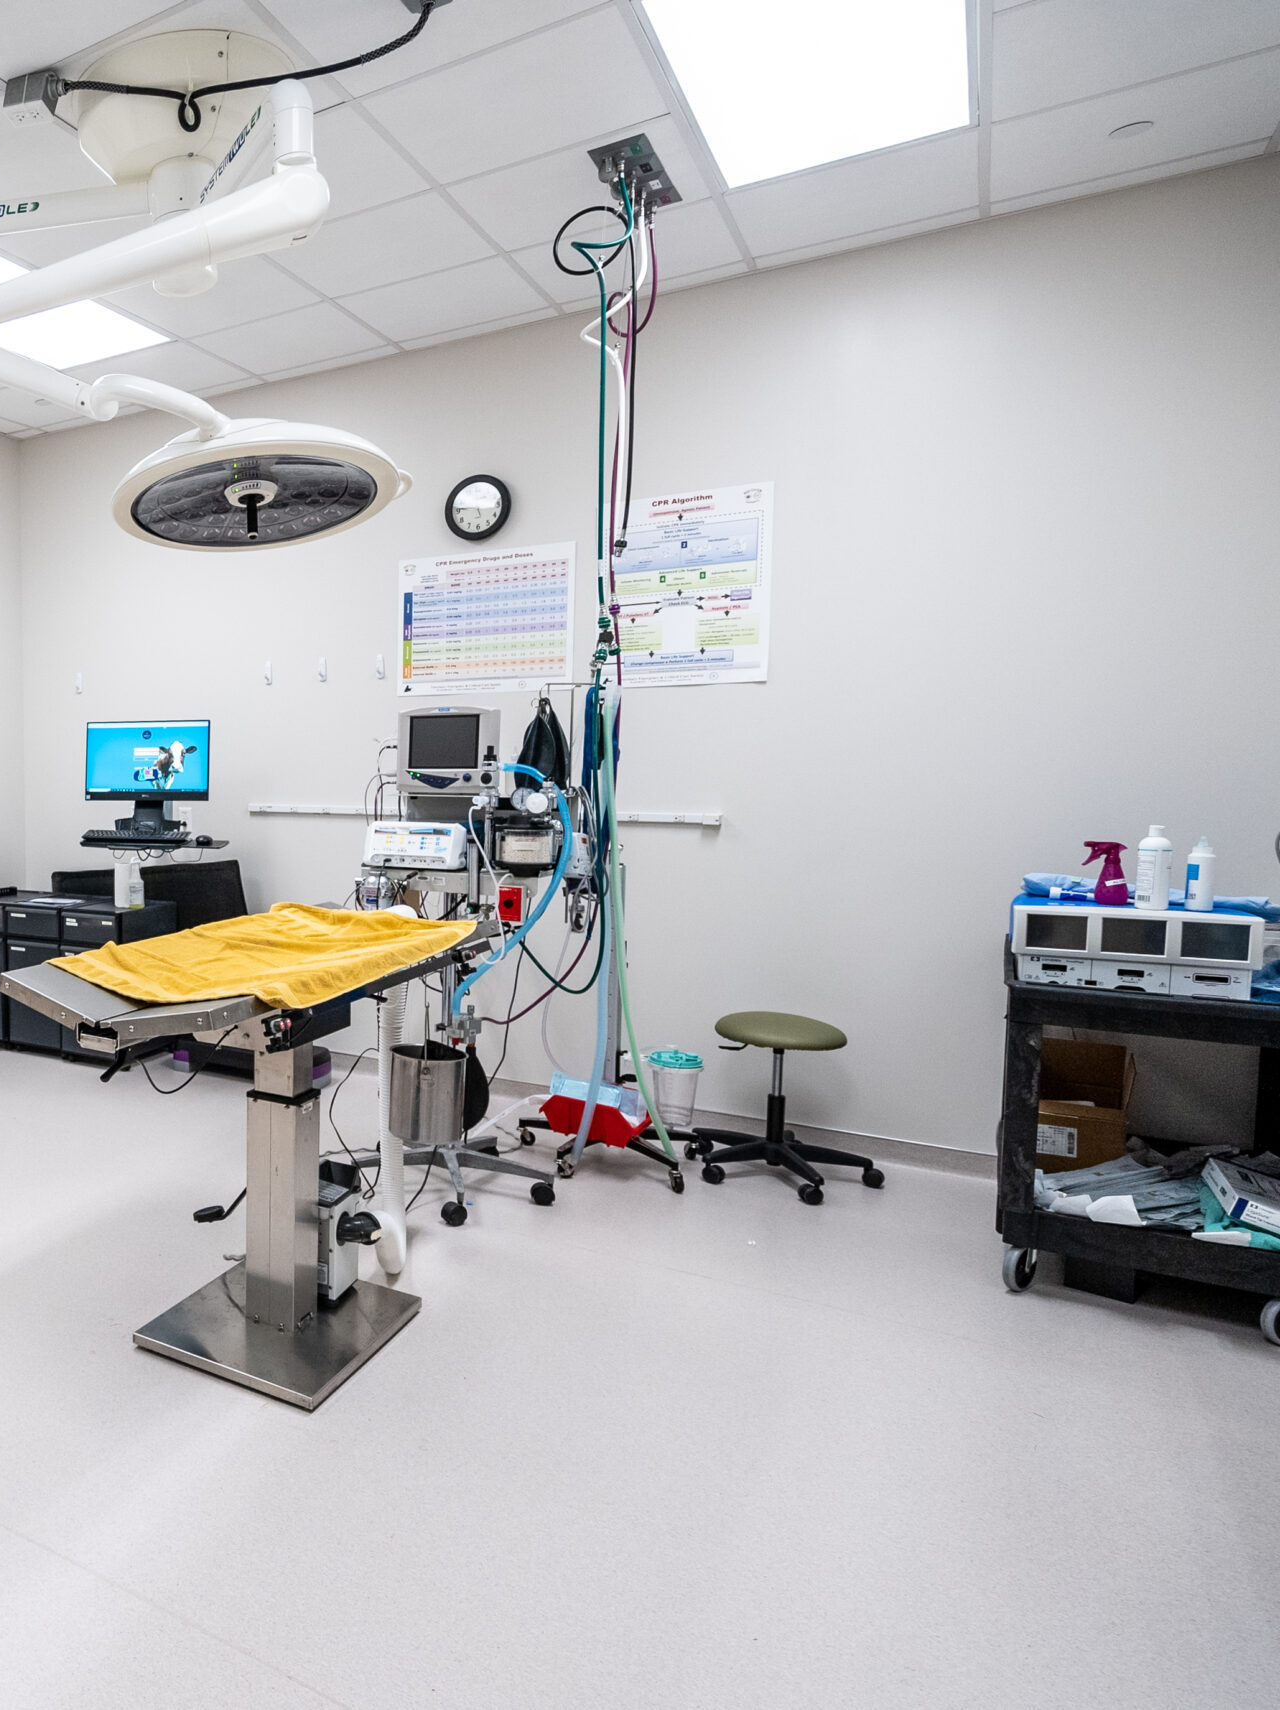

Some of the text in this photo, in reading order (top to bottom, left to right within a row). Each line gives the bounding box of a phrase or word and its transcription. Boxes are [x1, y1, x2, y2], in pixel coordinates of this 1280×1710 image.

[651, 494, 713, 507] CPR Algorithm
[476, 523, 481, 531] 6
[486, 519, 490, 527] 5
